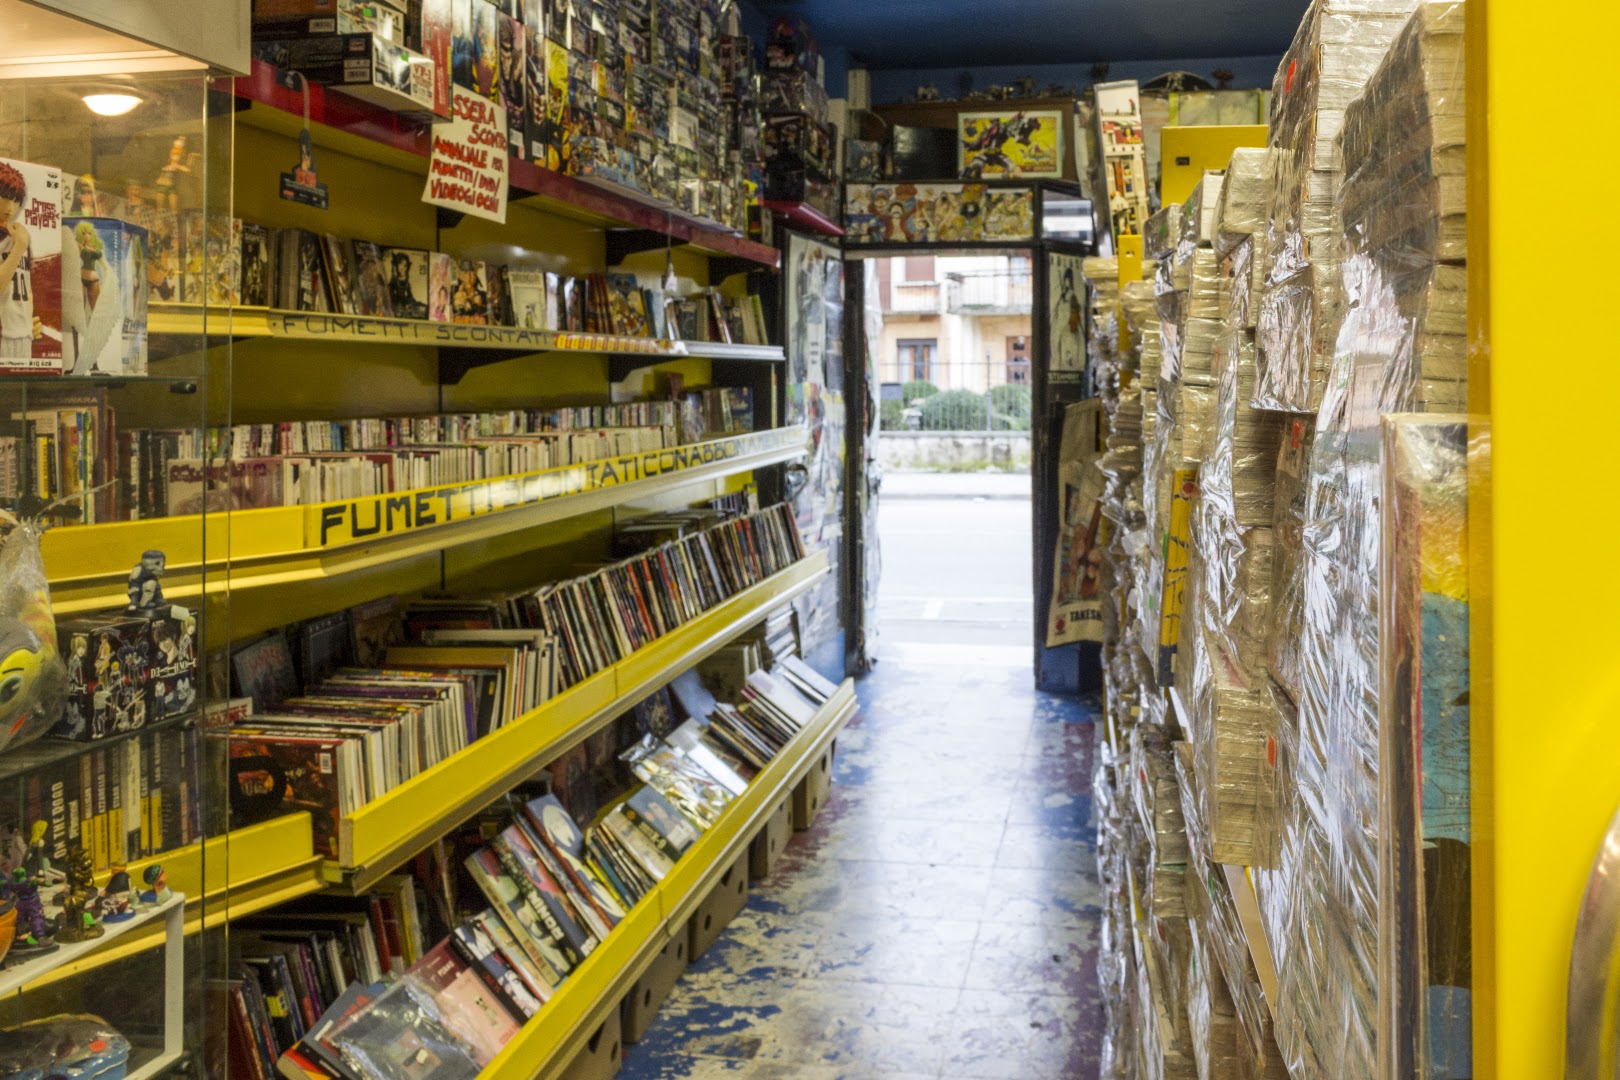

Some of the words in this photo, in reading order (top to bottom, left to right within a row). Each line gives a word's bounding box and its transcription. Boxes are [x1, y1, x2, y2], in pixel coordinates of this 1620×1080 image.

[453, 94, 497, 129] SSERA
[433, 135, 487, 169] ANNUALE
[283, 314, 418, 339] FUMETTI
[436, 324, 550, 345] SCONTATI
[321, 484, 492, 546] FUMETTI
[51, 781, 65, 813] ROAD
[52, 814, 66, 840] THE
[53, 840, 67, 859] ON
[527, 891, 565, 940] RONIN
